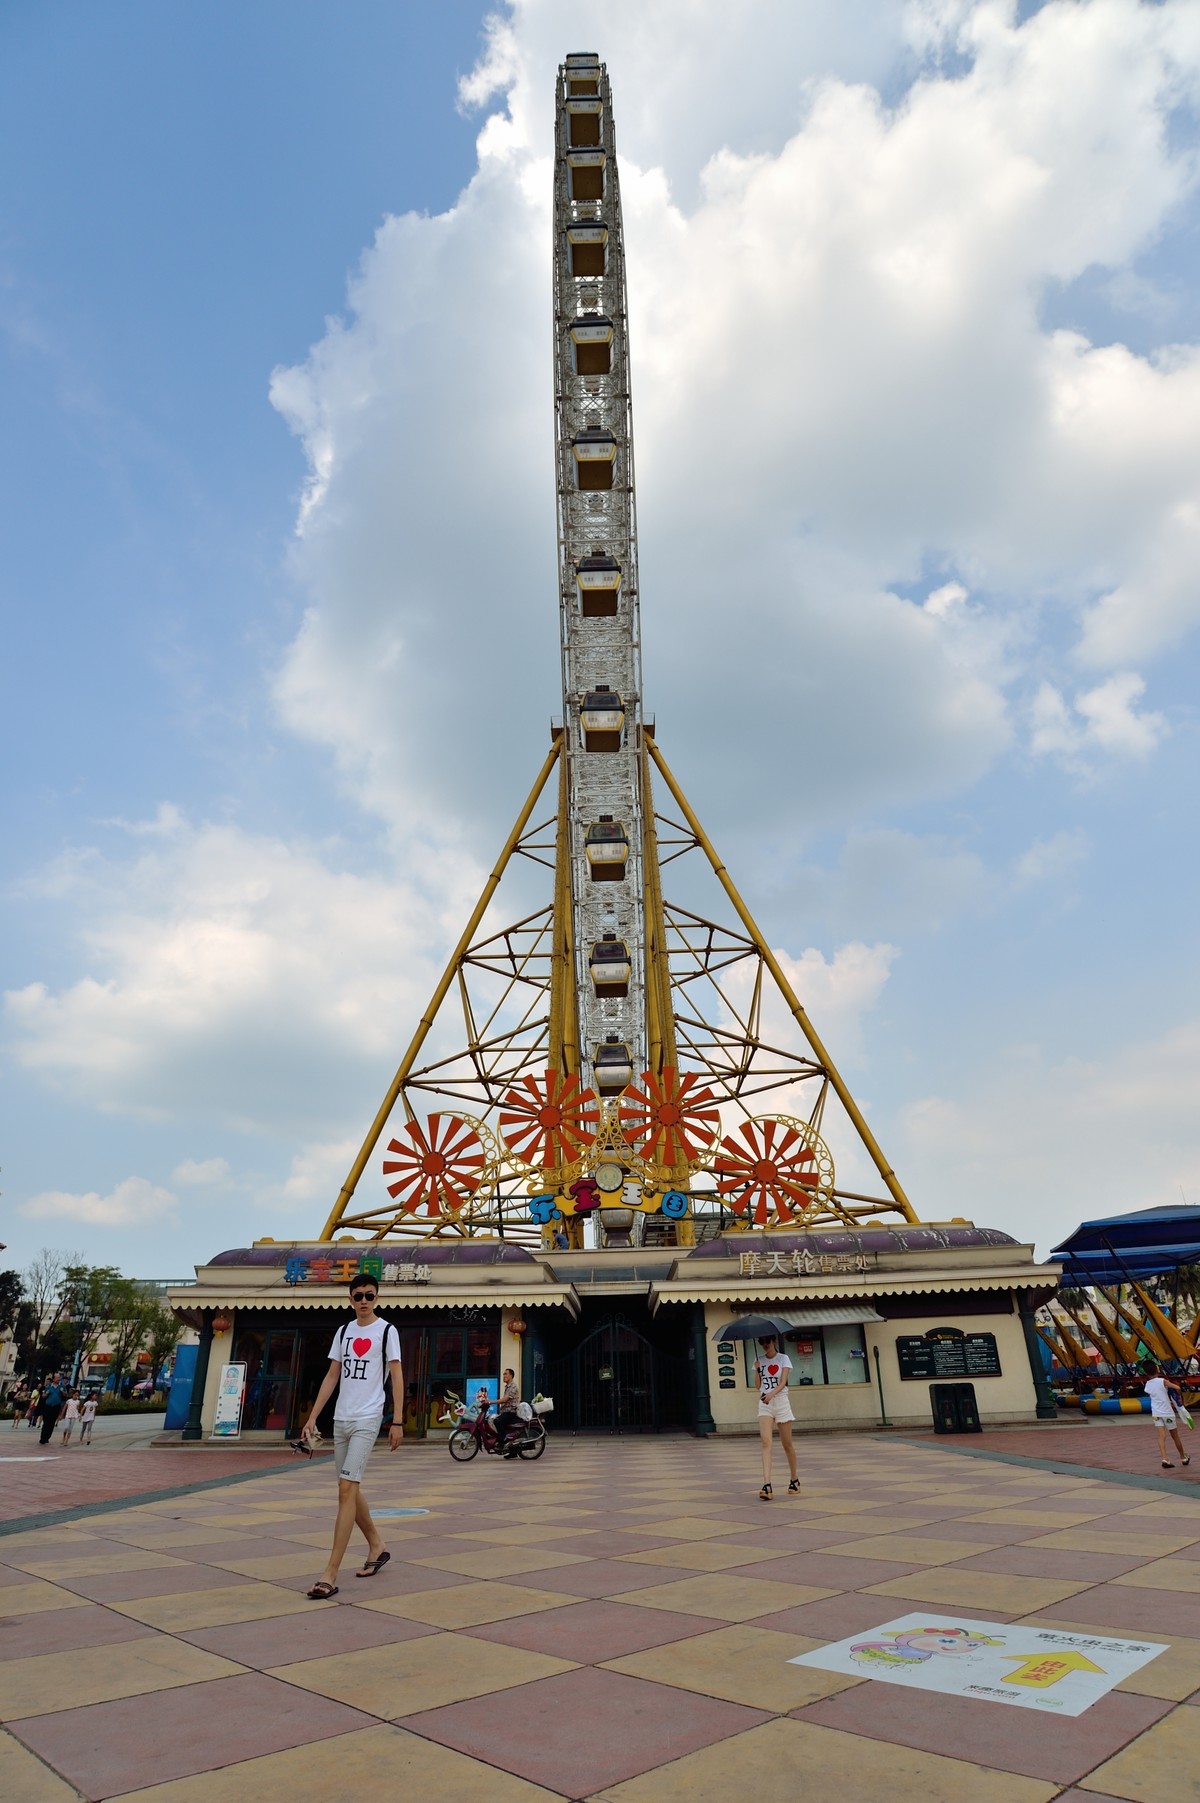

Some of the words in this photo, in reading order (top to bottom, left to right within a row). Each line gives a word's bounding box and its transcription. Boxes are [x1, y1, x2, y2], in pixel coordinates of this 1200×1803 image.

[739, 1248, 871, 1276] 摩天轮售票处
[343, 1337, 353, 1357] I
[343, 1358, 370, 1380] SH
[762, 1377, 779, 1390] SH
[1020, 1660, 1067, 1681] 由此去
